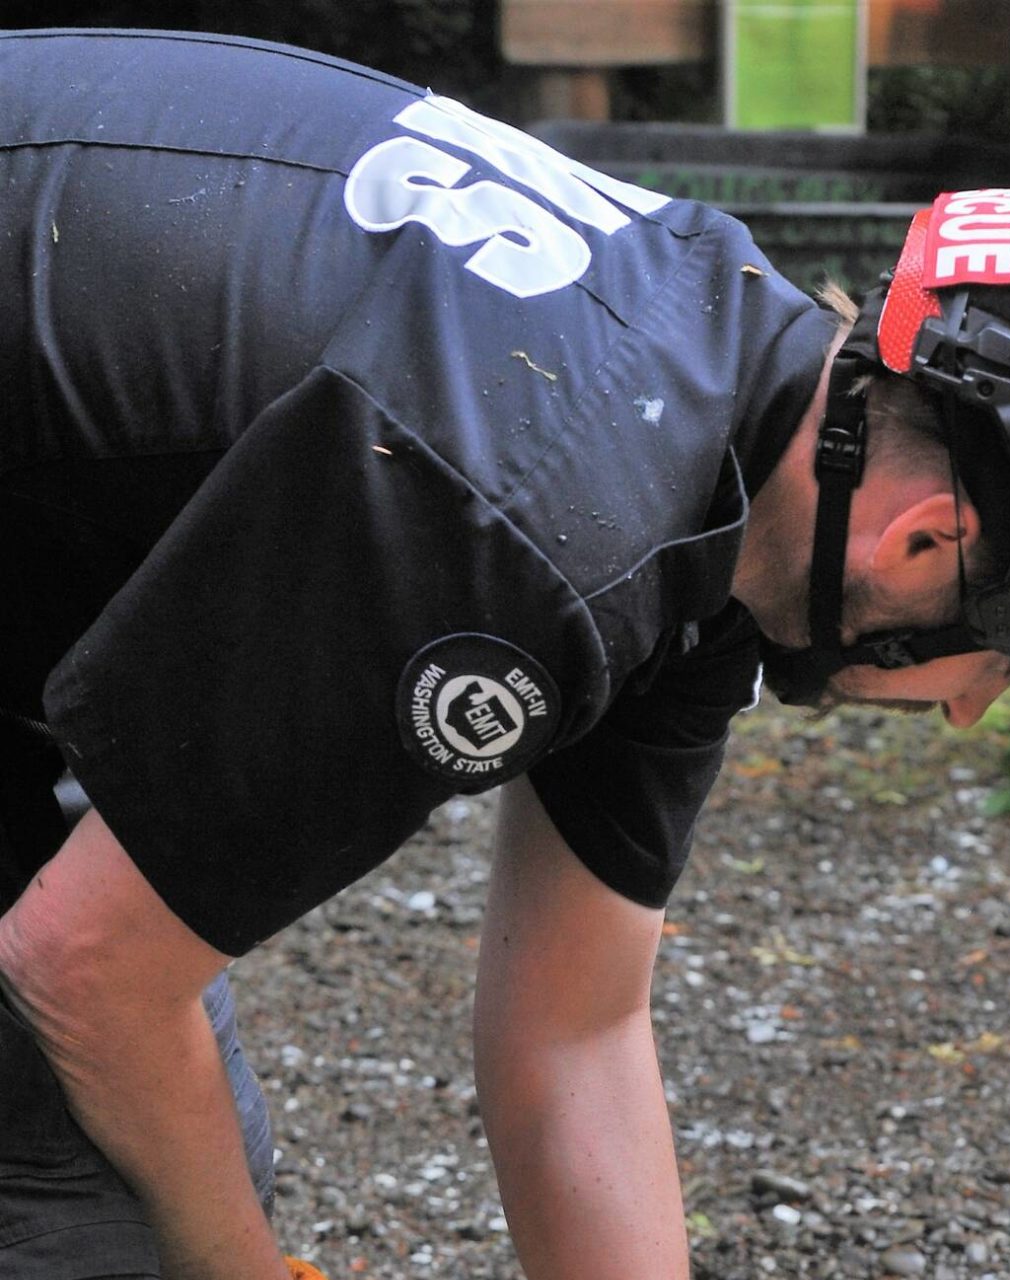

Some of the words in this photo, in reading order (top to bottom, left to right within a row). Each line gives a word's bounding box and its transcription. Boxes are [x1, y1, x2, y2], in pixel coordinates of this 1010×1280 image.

[504, 667, 548, 717] EMT-IV
[411, 663, 454, 764] WASHINGTON
[452, 757, 504, 774] STATE
[464, 703, 507, 741] EMT
